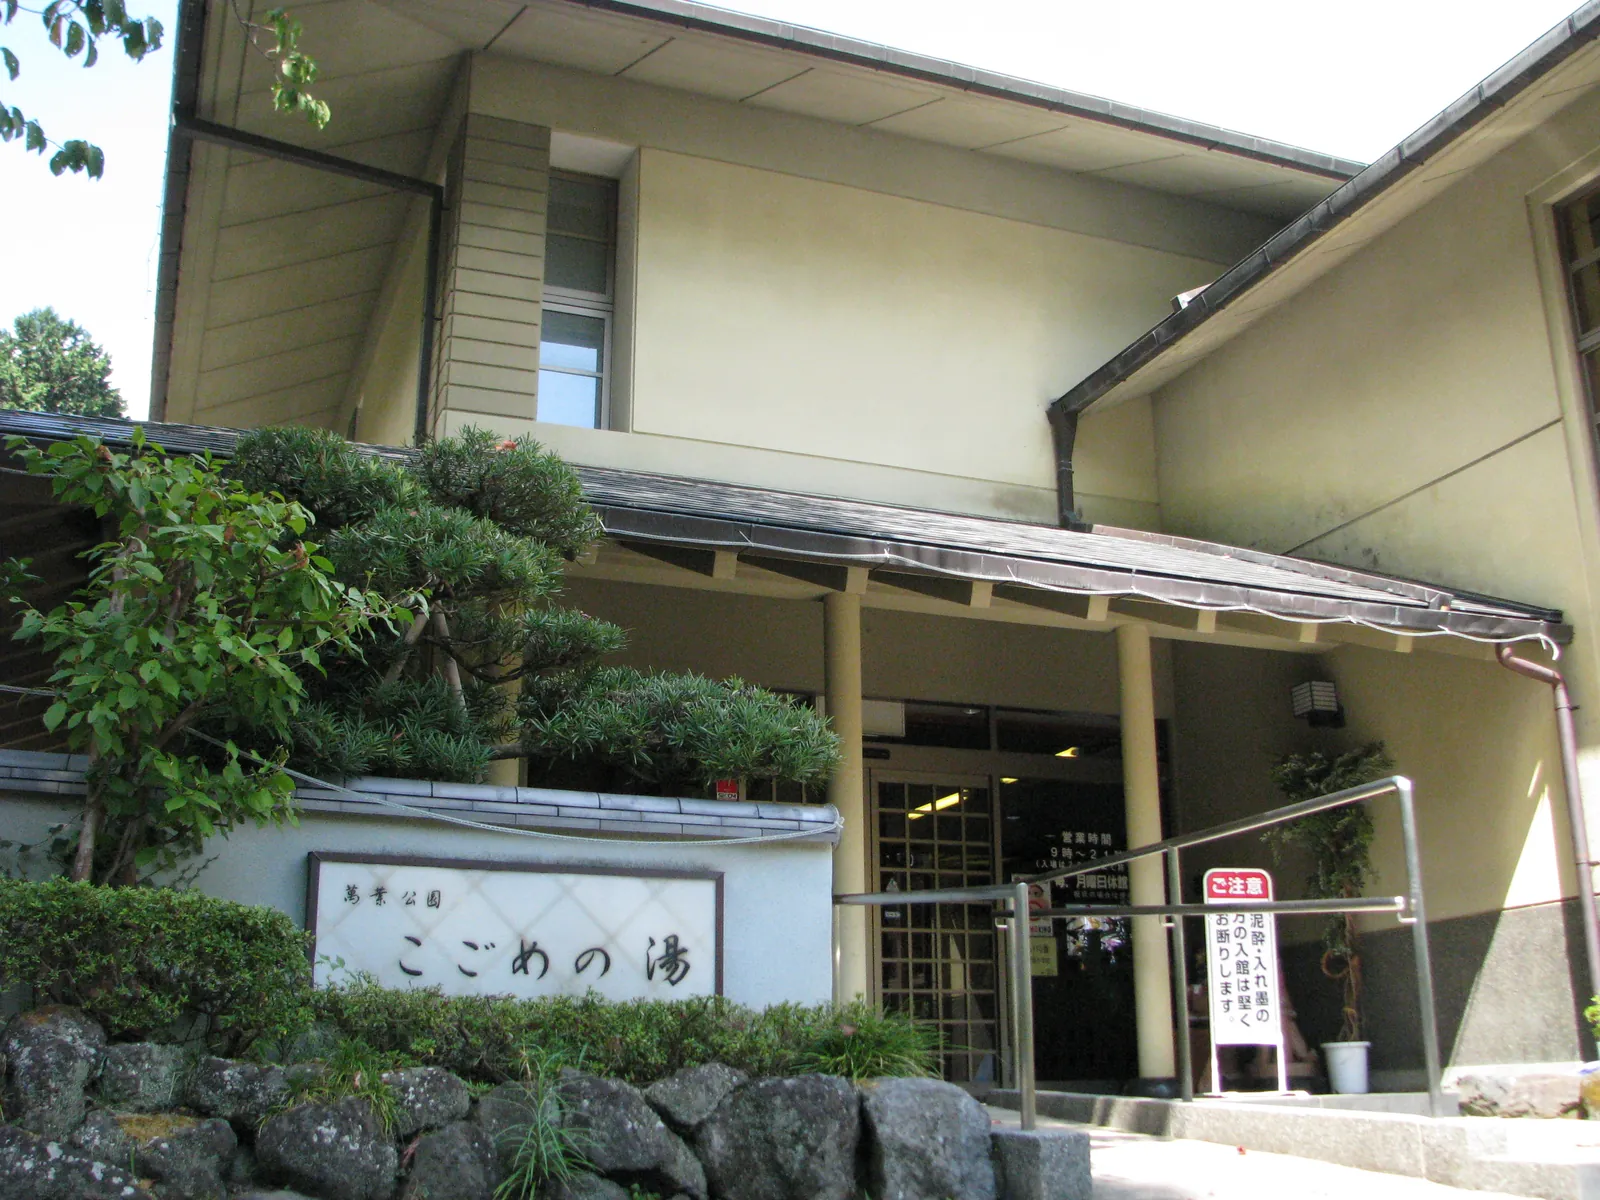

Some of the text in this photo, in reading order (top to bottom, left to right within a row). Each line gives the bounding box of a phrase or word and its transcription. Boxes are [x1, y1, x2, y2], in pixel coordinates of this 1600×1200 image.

[1062, 831, 1112, 846] 営業時間
[1212, 877, 1263, 894] ご注意
[344, 884, 441, 909] 萬葉公園
[399, 934, 691, 986] こごめの湯
